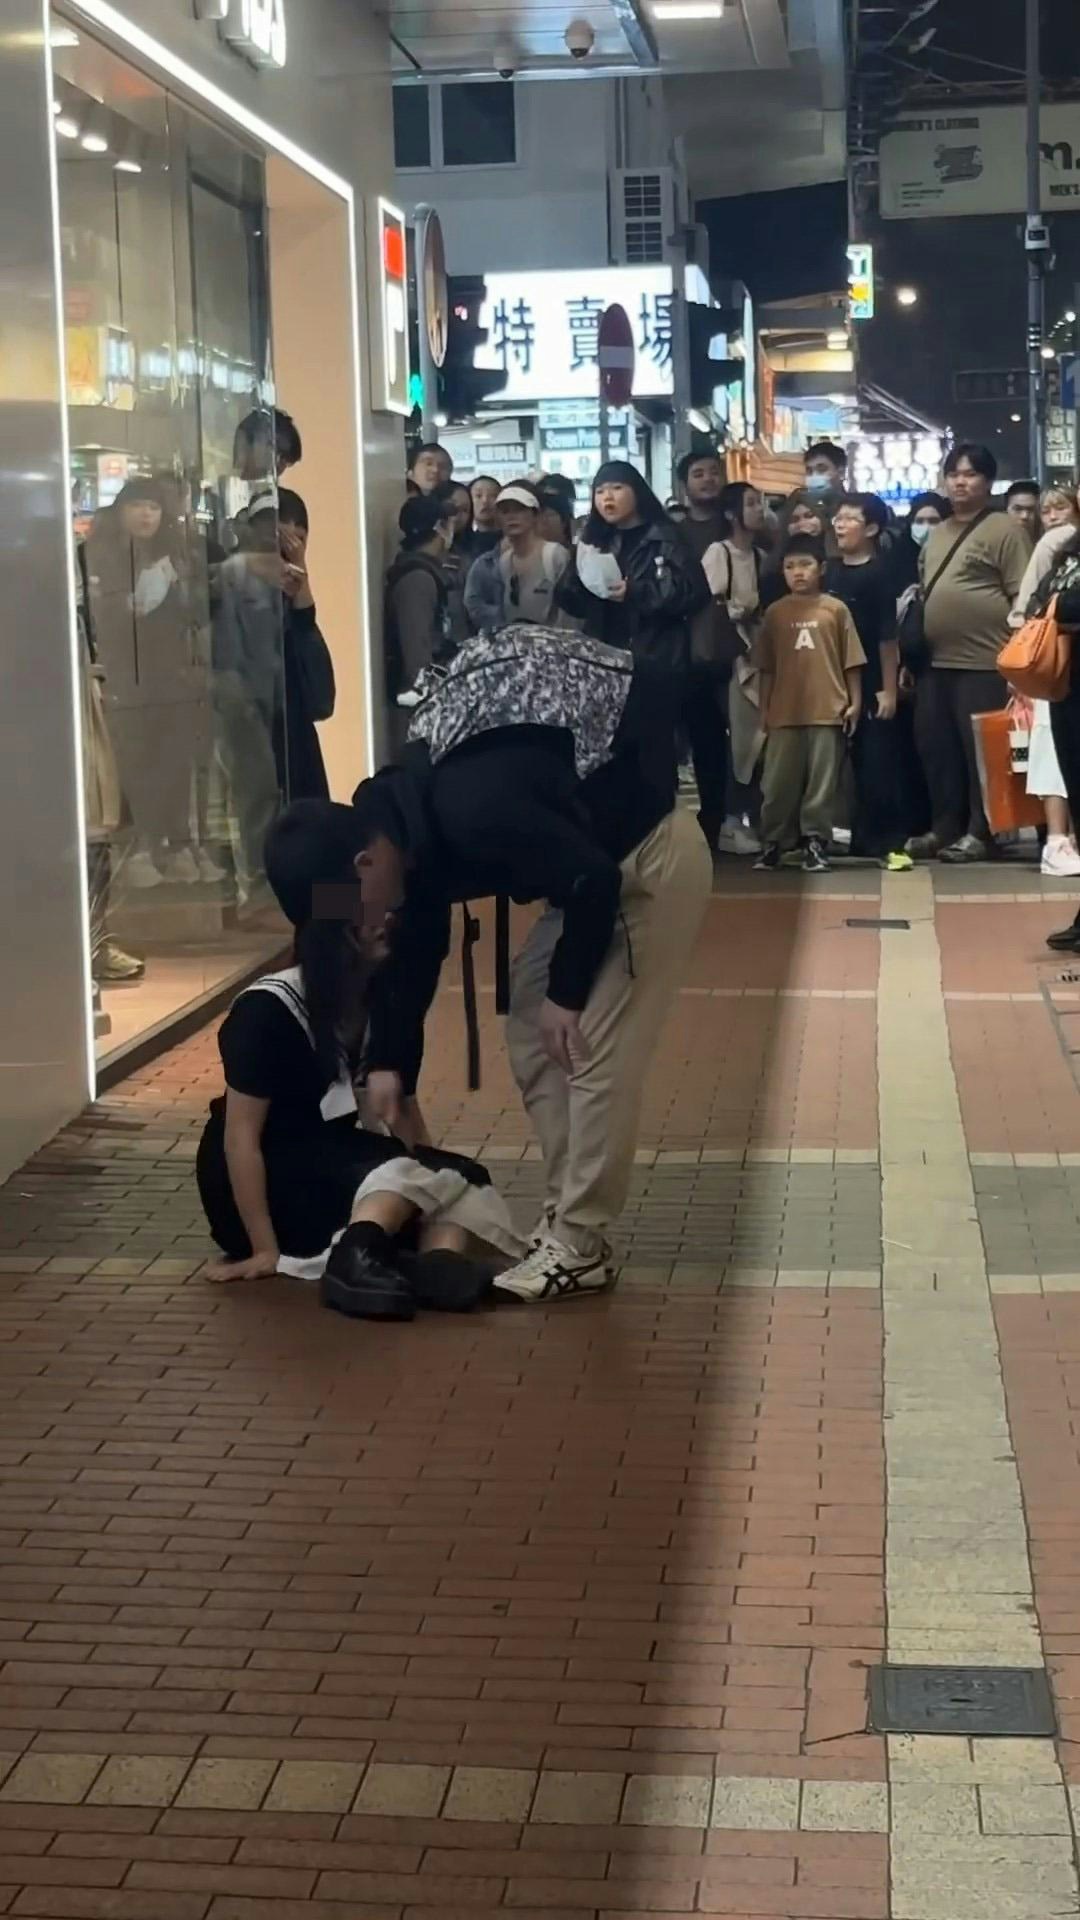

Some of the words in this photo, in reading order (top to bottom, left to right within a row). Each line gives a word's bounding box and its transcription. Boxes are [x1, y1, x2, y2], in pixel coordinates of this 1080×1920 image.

[493, 292, 673, 374] 特賣場
[794, 628, 816, 650] A
